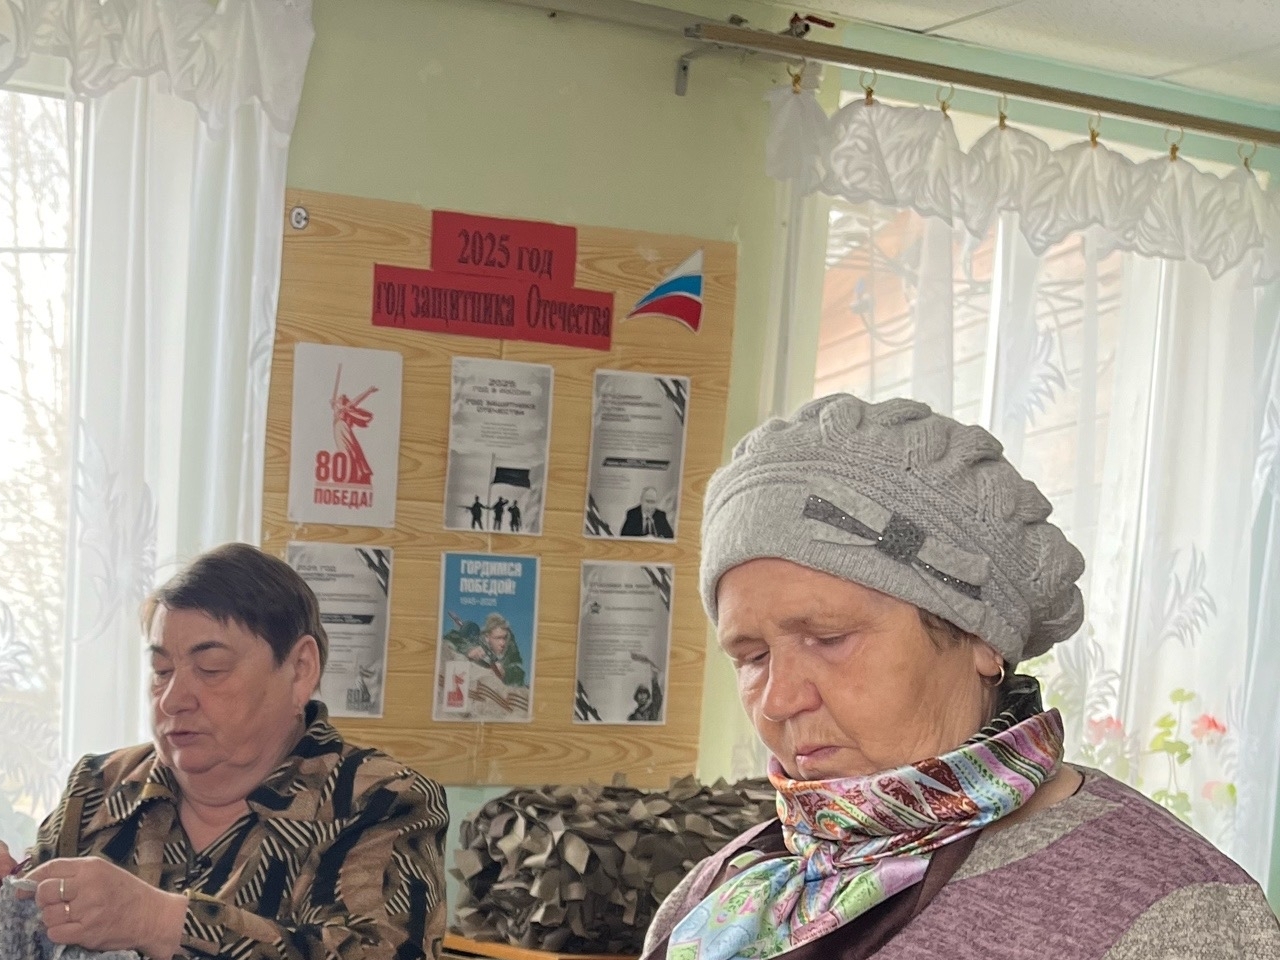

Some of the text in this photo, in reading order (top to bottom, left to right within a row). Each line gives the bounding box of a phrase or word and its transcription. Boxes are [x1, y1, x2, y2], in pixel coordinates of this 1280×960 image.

[457, 229, 554, 280] 2025 год
[411, 283, 516, 328] защитника
[526, 284, 612, 338] Отечества
[316, 450, 347, 482] 80
[314, 488, 373, 509] ПОБЕДА!
[461, 559, 522, 578] ГОРДИМСЯ
[460, 577, 516, 596] ПОБЕДОЙ!
